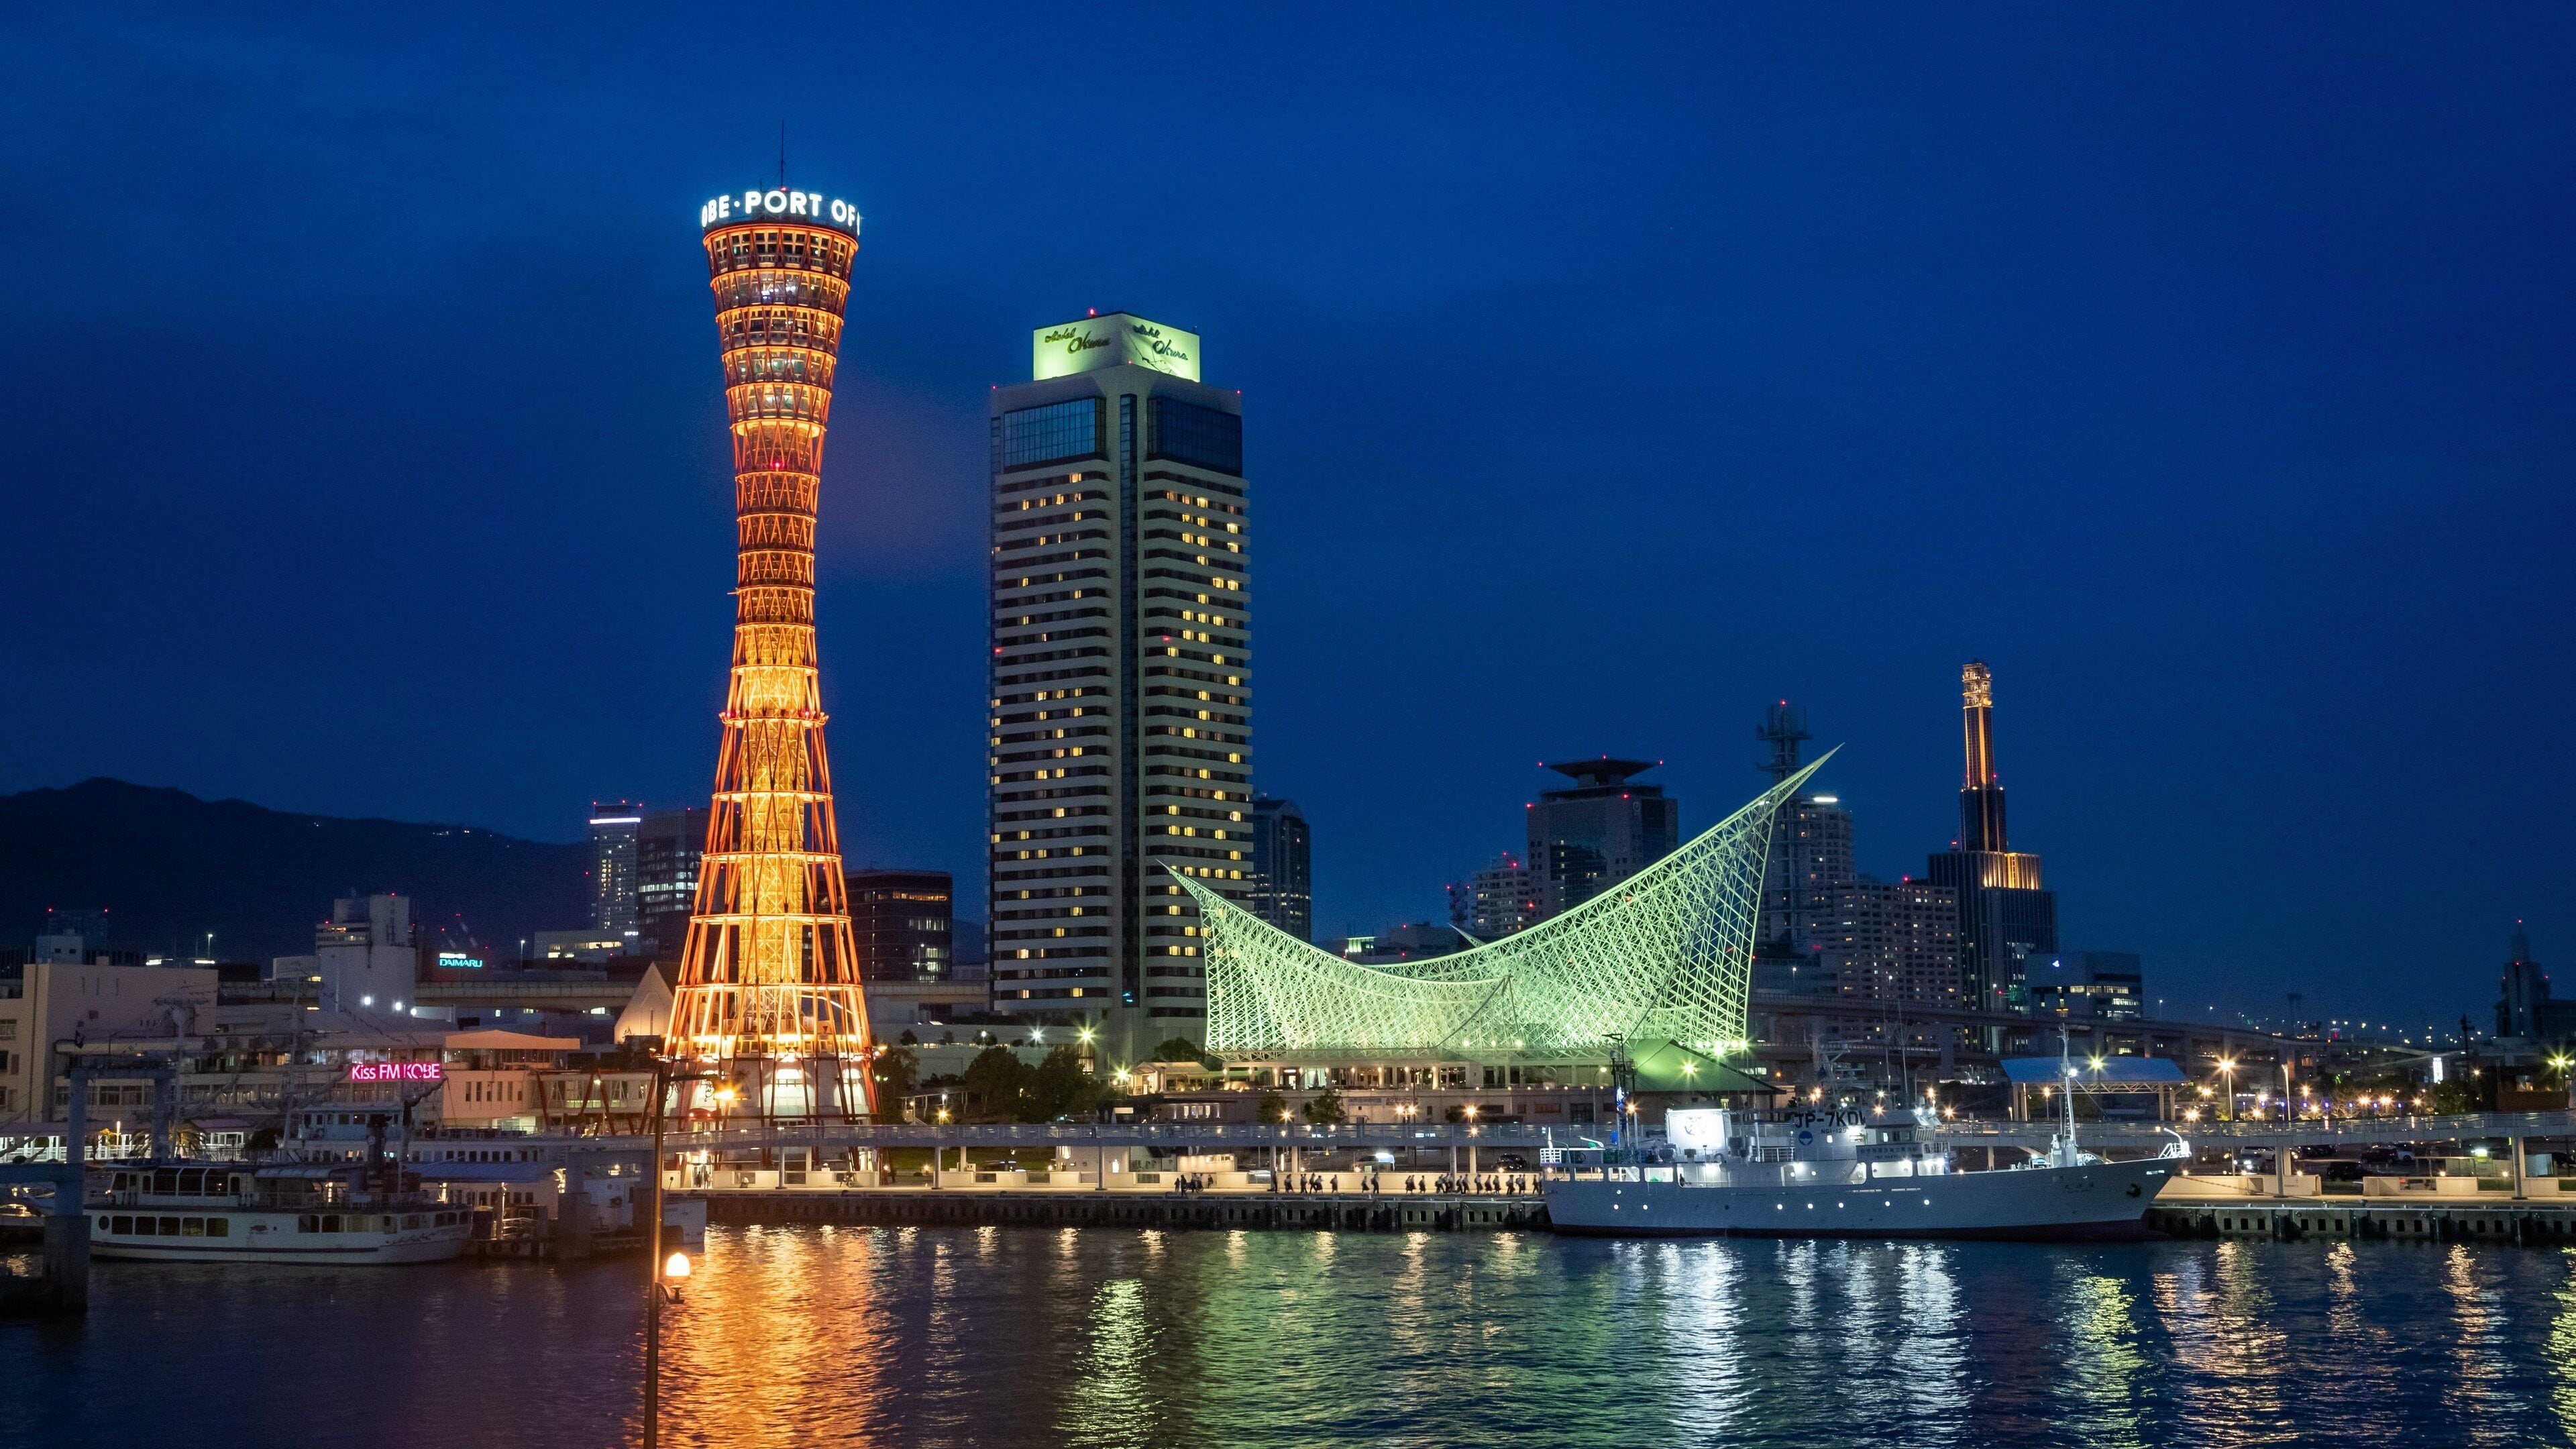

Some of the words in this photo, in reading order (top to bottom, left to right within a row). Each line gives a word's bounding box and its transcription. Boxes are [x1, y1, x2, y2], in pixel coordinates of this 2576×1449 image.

[745, 191, 822, 216] PORT
[831, 199, 855, 227] OF
[1067, 330, 1110, 354] Okura
[1152, 339, 1188, 360] Okura
[439, 959, 482, 967] DAIMARU
[352, 1064, 376, 1079] Kiss
[380, 1065, 400, 1079] FM
[403, 1063, 440, 1079] KOBE
